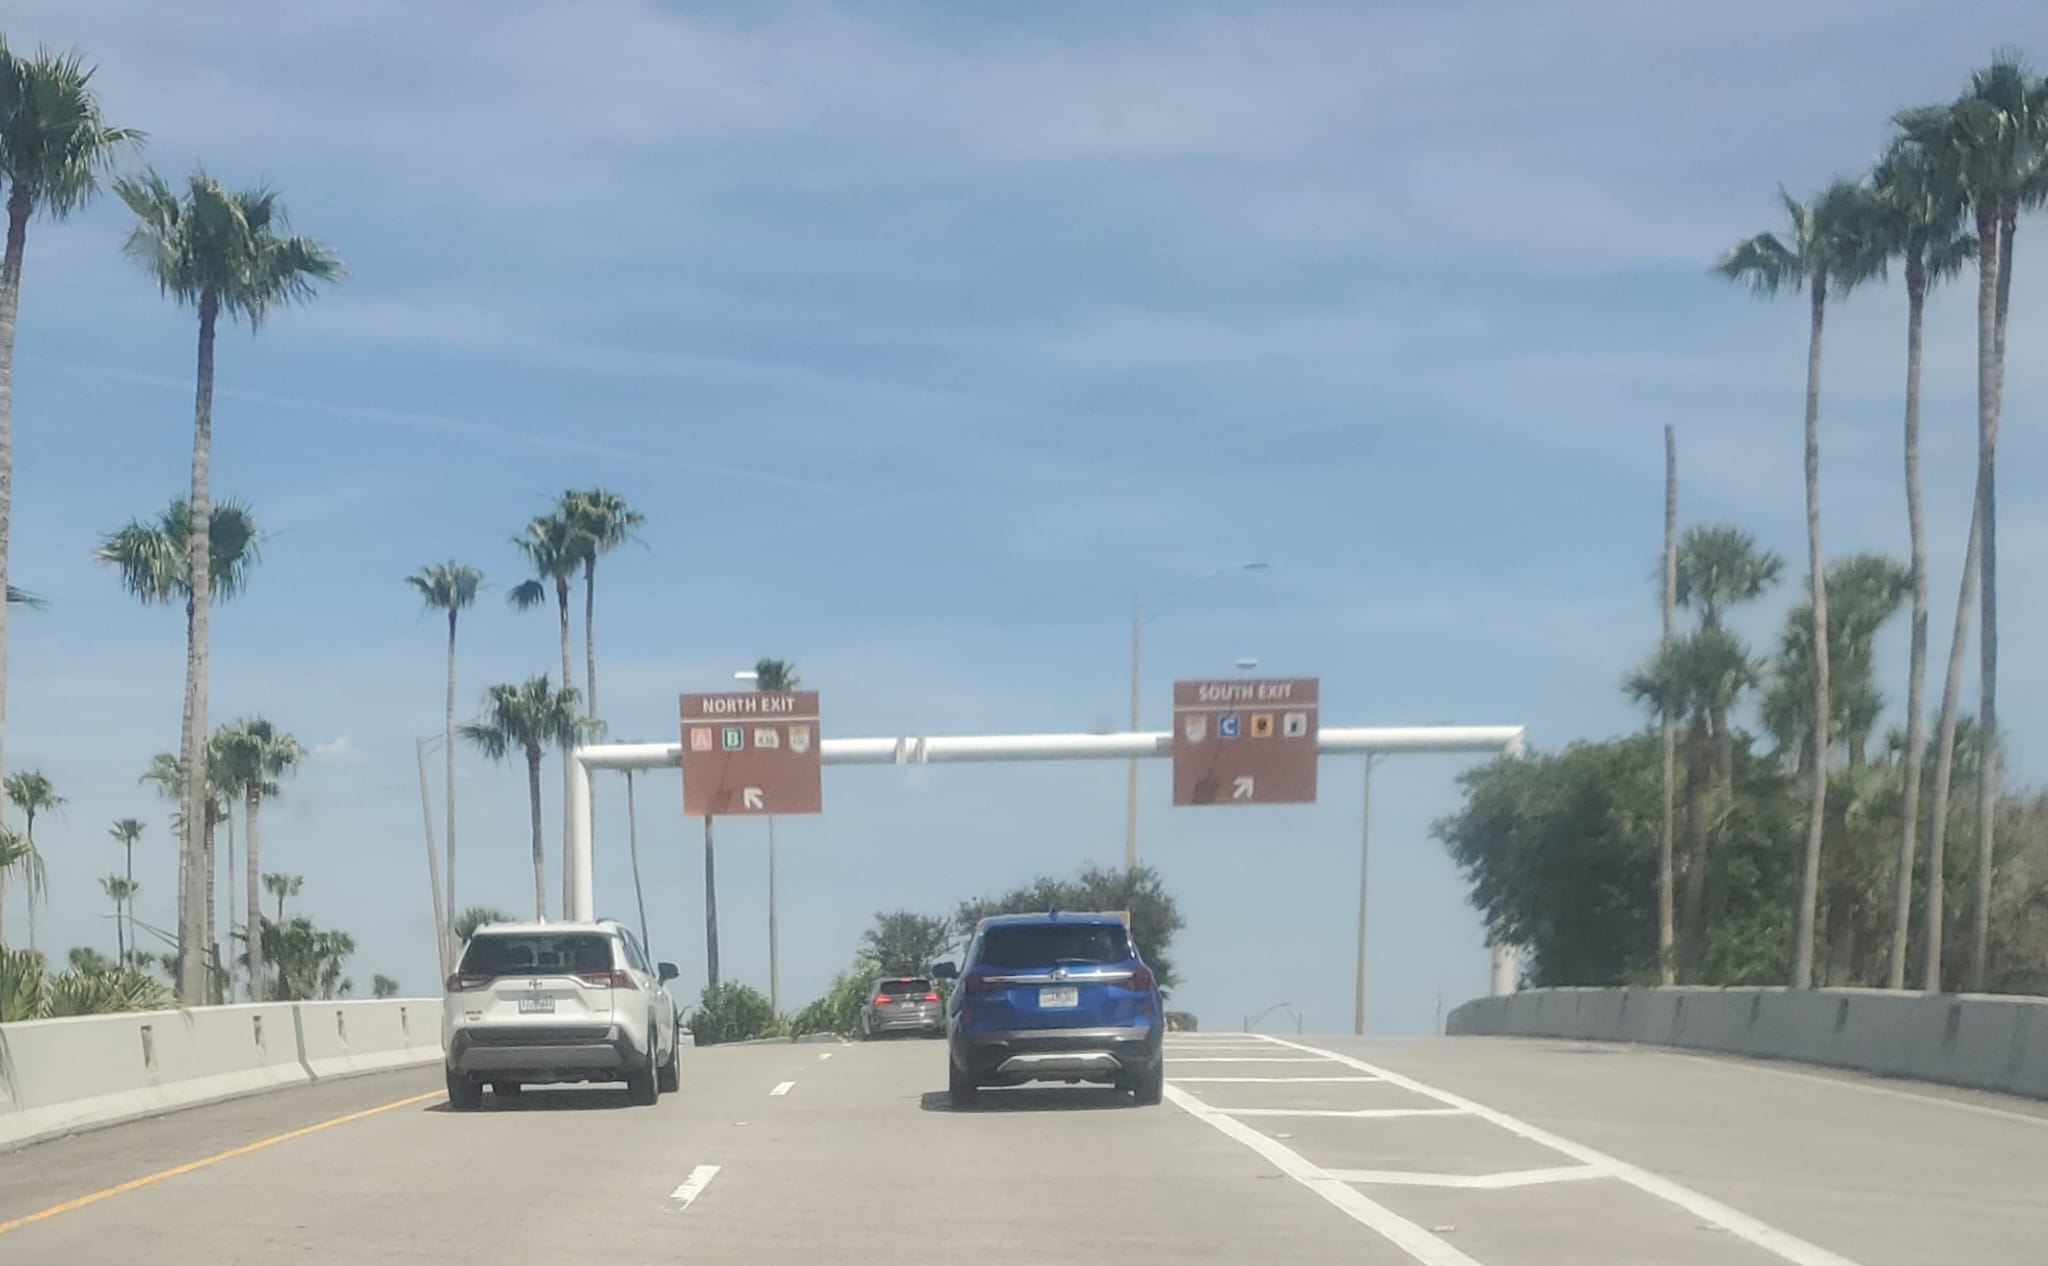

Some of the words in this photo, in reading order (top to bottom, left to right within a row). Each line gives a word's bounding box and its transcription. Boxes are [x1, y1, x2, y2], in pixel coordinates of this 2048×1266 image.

[1199, 684, 1253, 701] SOUTH
[1258, 683, 1292, 699] EXIT
[703, 698, 756, 713] NORTH
[762, 697, 795, 712] EXIT
